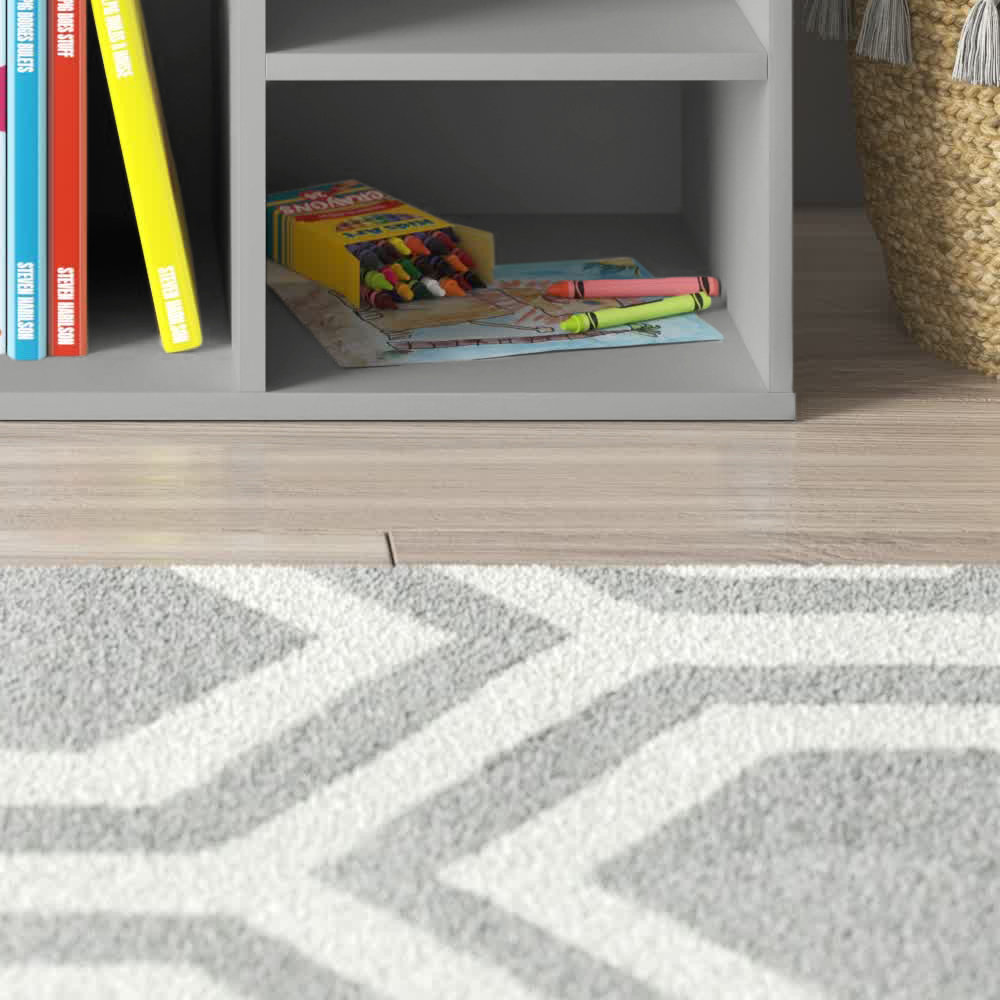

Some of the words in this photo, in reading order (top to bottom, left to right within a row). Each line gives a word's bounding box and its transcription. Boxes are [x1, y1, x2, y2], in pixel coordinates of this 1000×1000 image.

[17, 12, 35, 41] DODGES
[57, 12, 74, 32] DOES
[57, 34, 74, 57] STUFF
[17, 262, 35, 294] STEVEN
[57, 267, 75, 300] STEVEN
